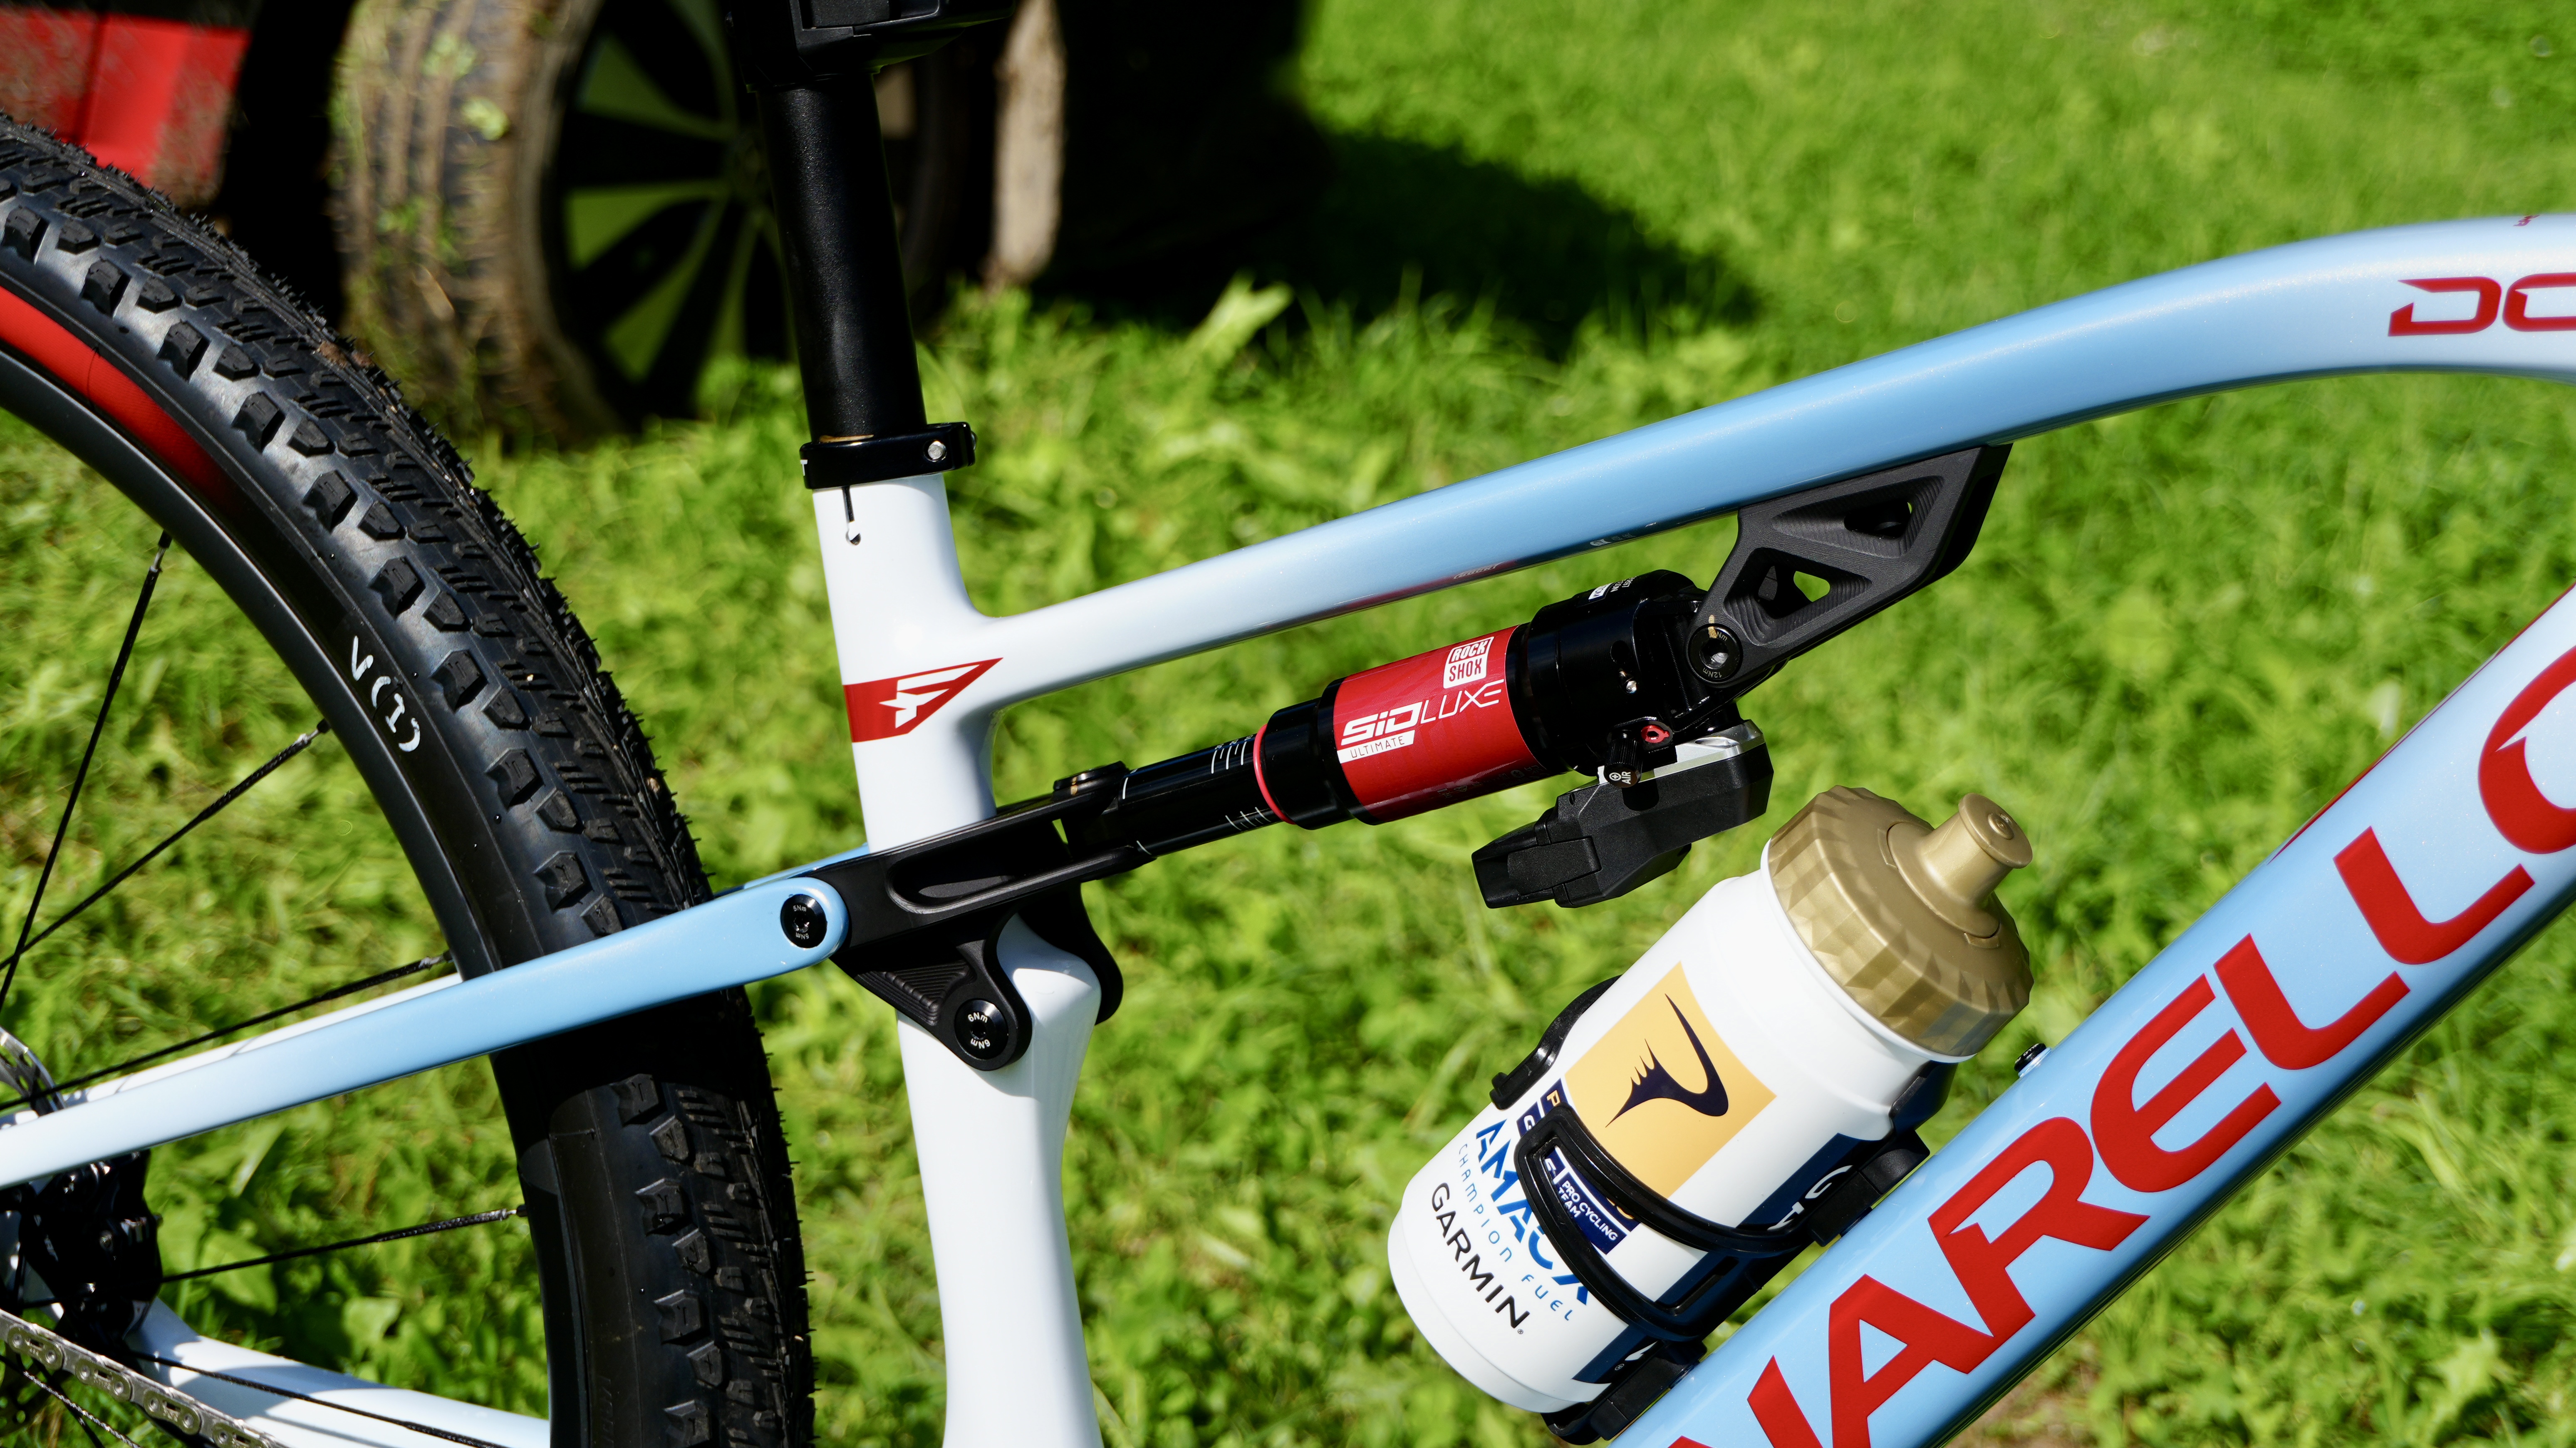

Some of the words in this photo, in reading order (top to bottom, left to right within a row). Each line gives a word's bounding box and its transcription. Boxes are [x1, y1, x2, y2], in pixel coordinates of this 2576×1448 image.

[1451, 640, 1488, 662] ROCK
[1449, 657, 1481, 682] SHOX
[1702, 667, 1722, 678] 12Nm
[1350, 736, 1404, 758] ULTIMATE
[1622, 771, 1631, 785] AIR
[968, 1012, 988, 1023] 6Nm
[970, 1038, 991, 1049] 6Nm
[1562, 1180, 1580, 1202] PRO
[1579, 1203, 1618, 1241] CYCLING
